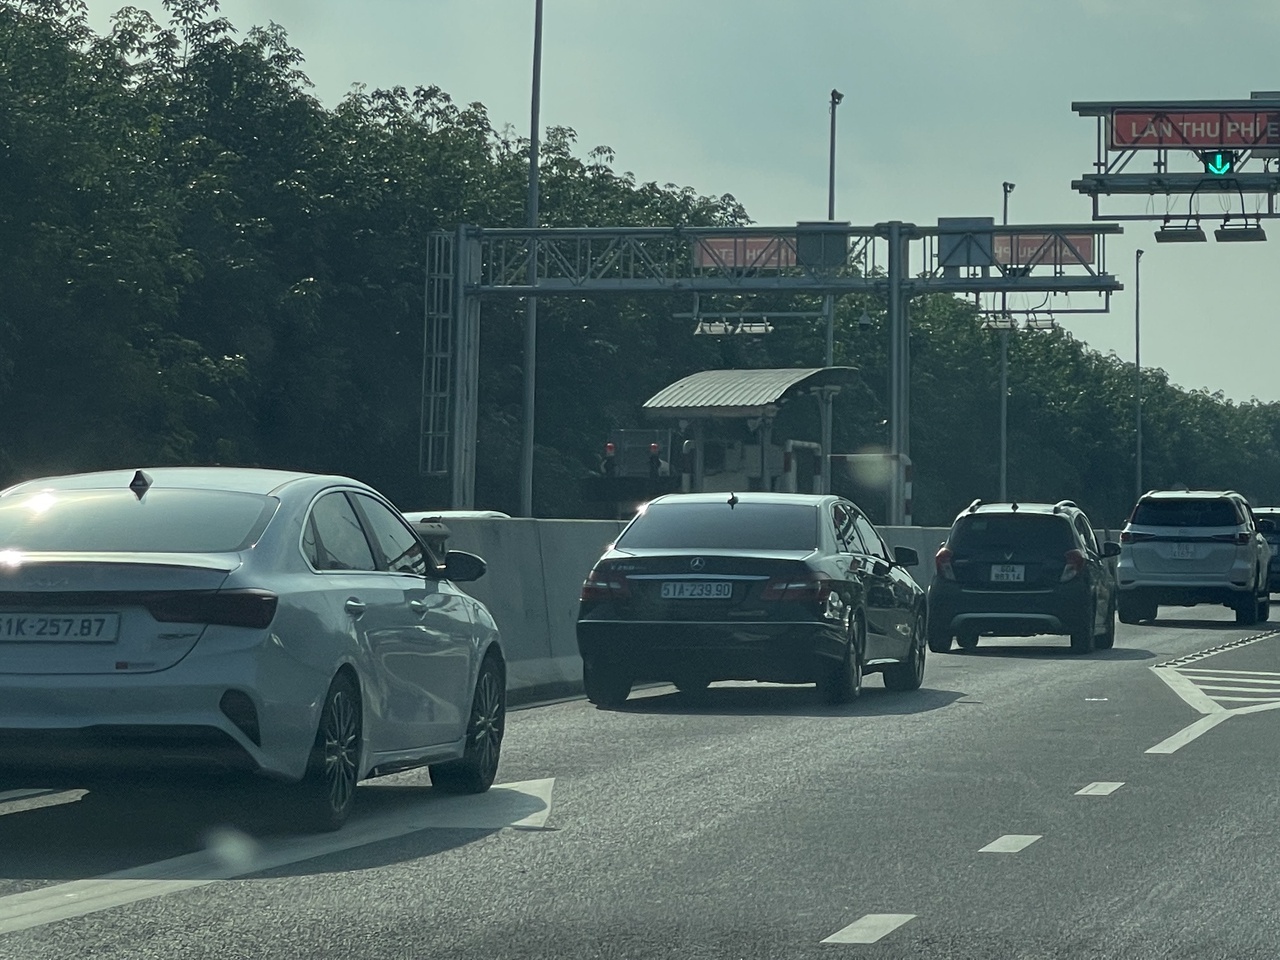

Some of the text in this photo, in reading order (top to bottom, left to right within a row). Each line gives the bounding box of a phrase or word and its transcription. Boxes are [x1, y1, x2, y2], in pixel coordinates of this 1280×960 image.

[1131, 117, 1173, 138] LÀN
[1178, 121, 1221, 138] THU
[1226, 117, 1261, 138] PHÍ
[662, 583, 731, 597] 51A-239.90
[0, 618, 106, 637] 1K-257.87
